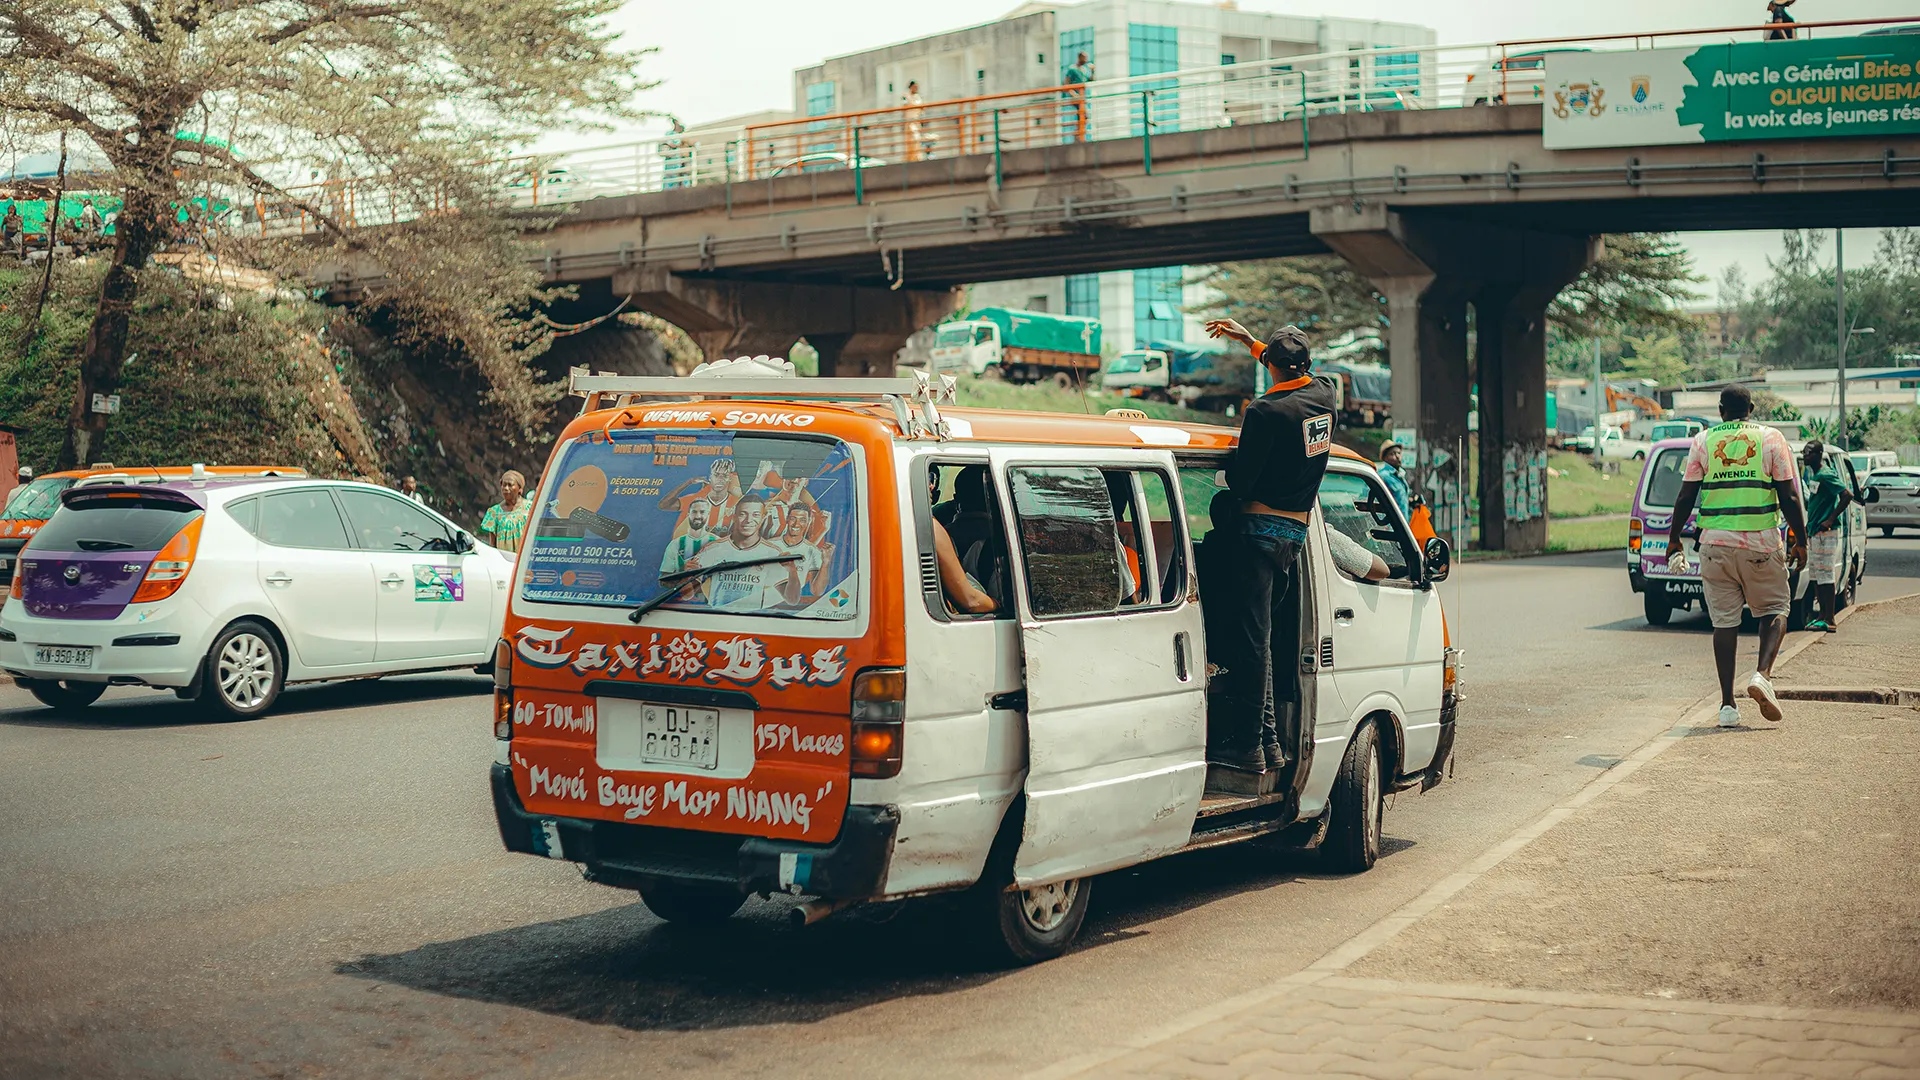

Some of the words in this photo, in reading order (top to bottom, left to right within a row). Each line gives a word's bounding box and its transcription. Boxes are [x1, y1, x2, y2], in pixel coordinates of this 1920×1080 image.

[1712, 69, 1760, 87] Avec
[1763, 66, 1781, 84] le
[1783, 61, 1860, 83] Général
[1863, 60, 1912, 79] Brice
[1769, 86, 1837, 107] OLIGUI
[1725, 111, 1744, 129] la
[1747, 109, 1786, 128] voix
[1789, 108, 1823, 126] des
[1825, 106, 1889, 129] jeunes
[642, 410, 712, 424] OUSMANE
[722, 410, 816, 427] SONKO
[610, 476, 650, 487] DÉCODEUR
[651, 478, 664, 487] HD
[1712, 470, 1757, 480] AWENDJE
[621, 487, 639, 495] 500
[639, 487, 660, 496] FCFA
[19, 526, 41, 536] Bu
[548, 547, 568, 556] POUR
[569, 545, 582, 556] 10
[583, 546, 603, 557] 500
[604, 547, 633, 558] FCFA
[718, 571, 761, 583] Emirates
[1665, 581, 1682, 593] LA
[515, 624, 664, 677] Taxi
[704, 634, 849, 687] Bus
[597, 775, 657, 820] Baye
[662, 779, 719, 817] Mor
